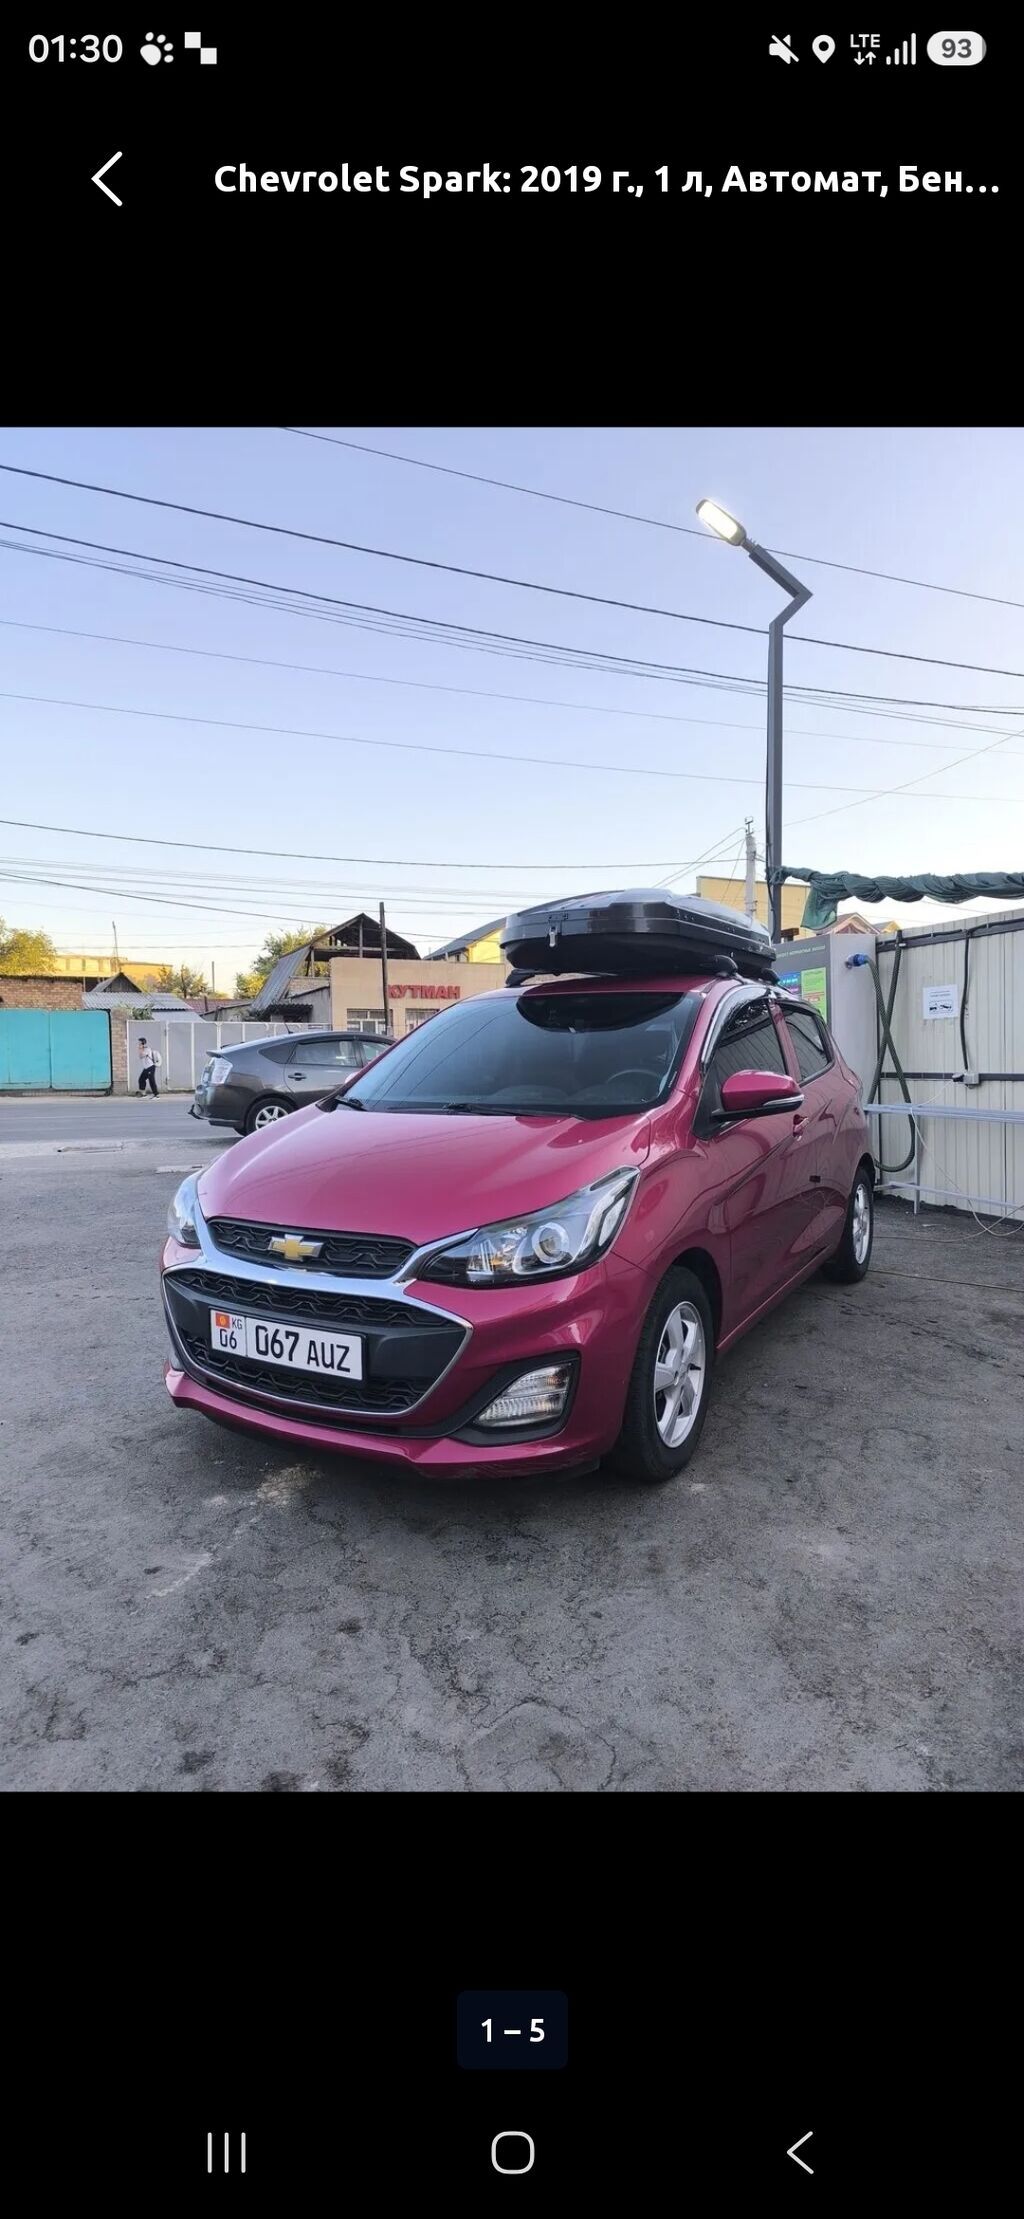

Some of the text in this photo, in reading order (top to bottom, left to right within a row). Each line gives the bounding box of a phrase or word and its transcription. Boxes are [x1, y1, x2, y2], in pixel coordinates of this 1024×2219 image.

[388, 984, 461, 999] КУТМАН
[231, 1318, 243, 1330] KG
[219, 1328, 237, 1350] 06
[255, 1325, 351, 1373] 067 AUZ
